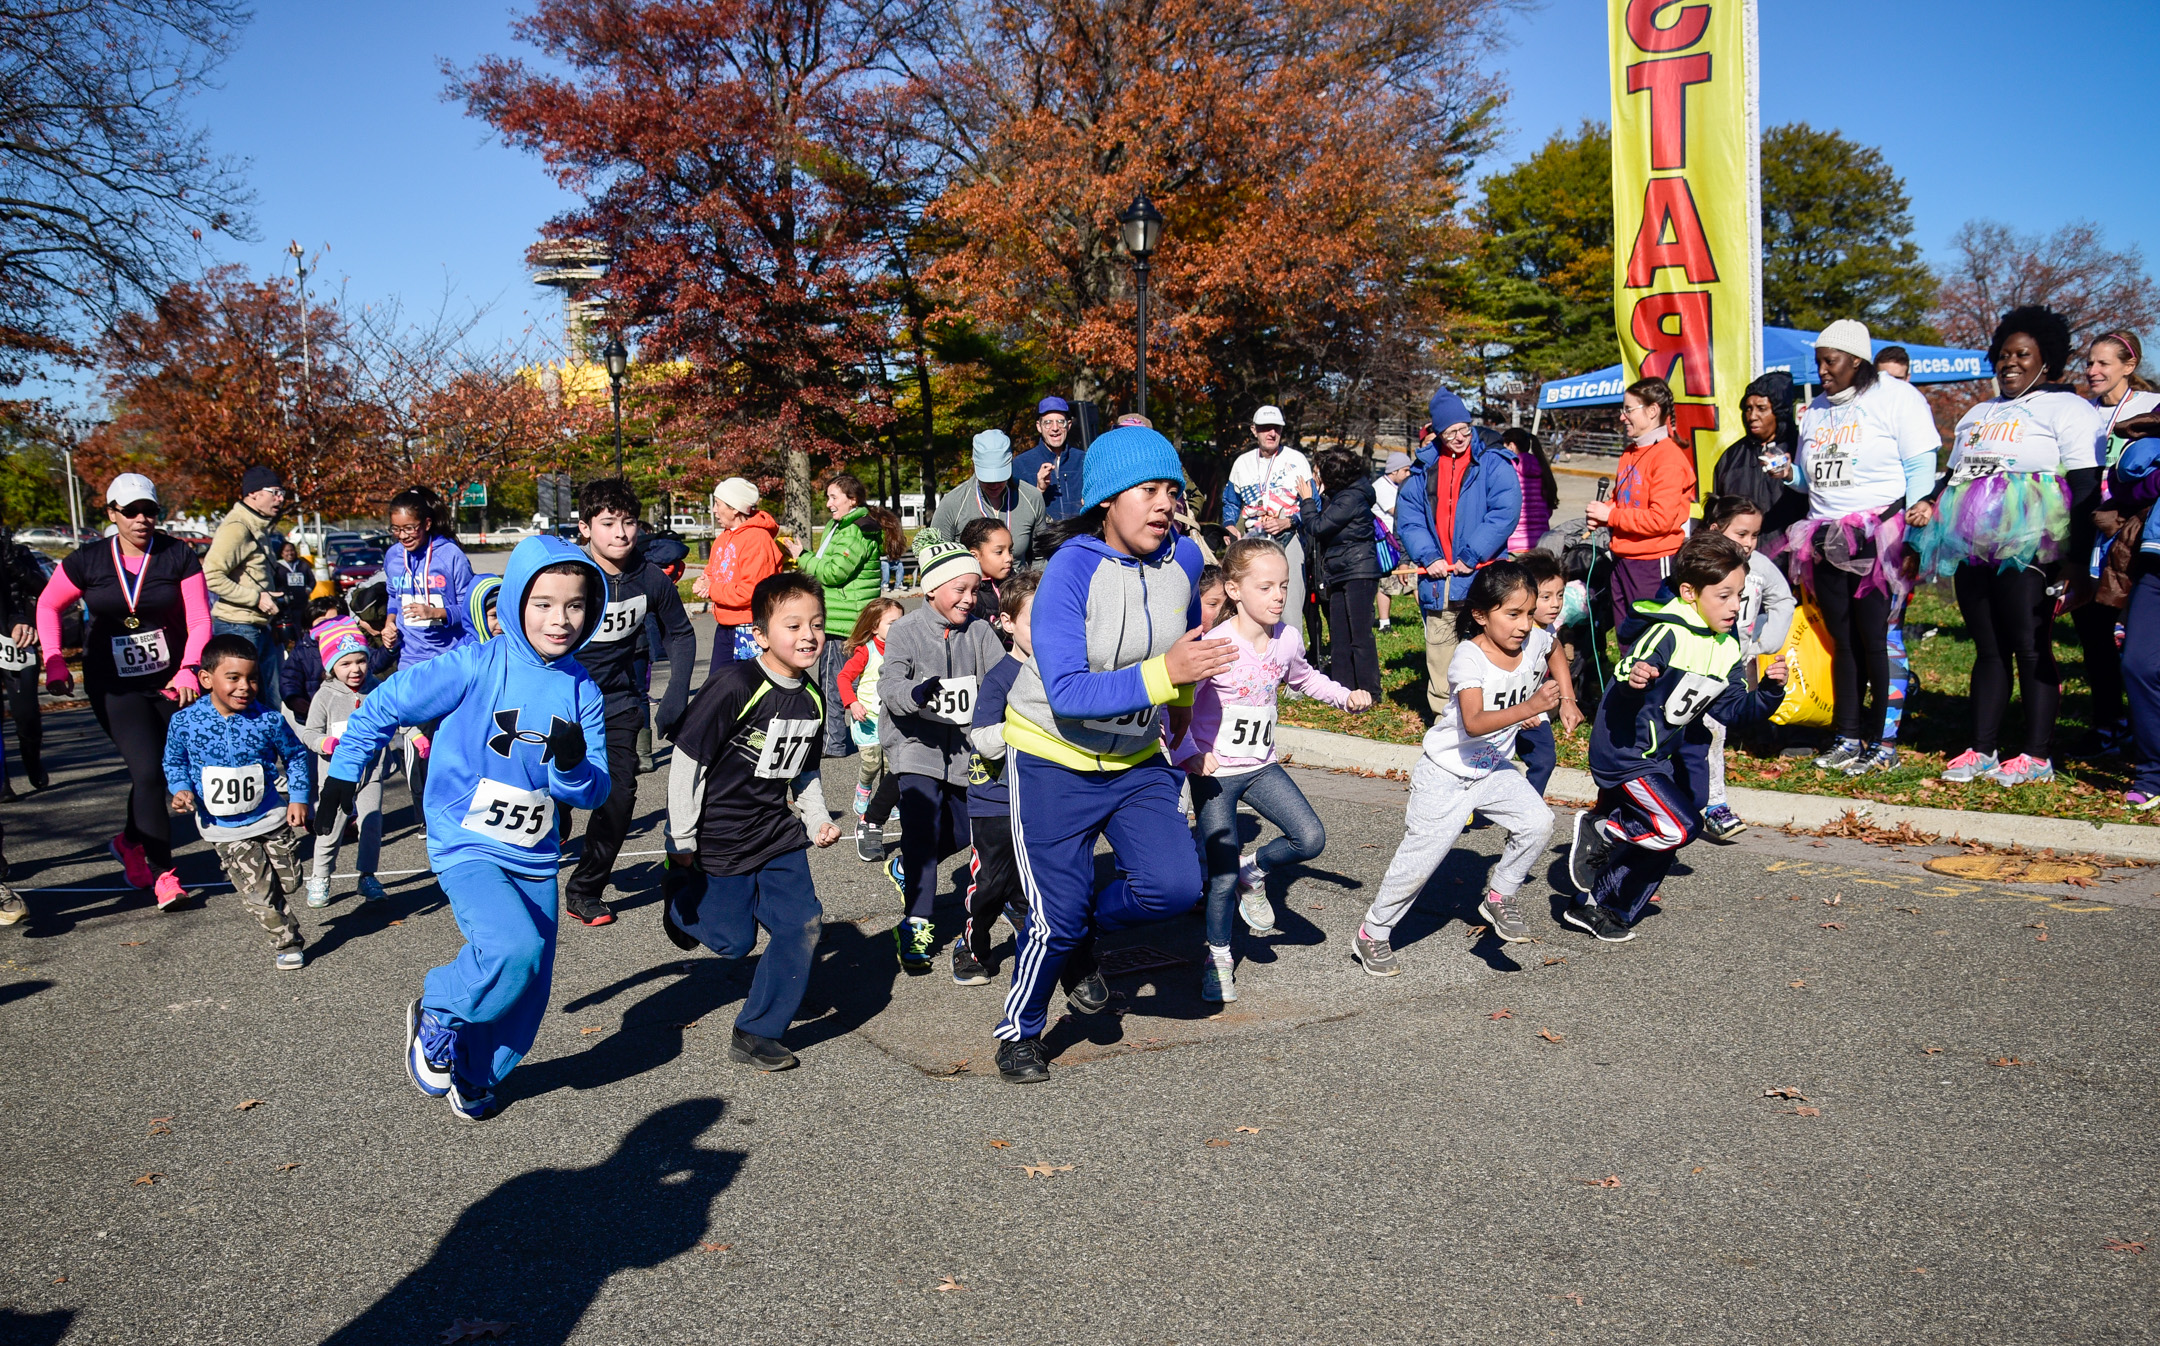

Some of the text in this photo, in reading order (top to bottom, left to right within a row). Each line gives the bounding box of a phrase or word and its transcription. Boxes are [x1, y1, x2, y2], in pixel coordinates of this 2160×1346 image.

[1815, 461, 1843, 479] 677
[603, 608, 636, 633] 551
[0, 641, 28, 664] 95
[123, 643, 160, 666] 635
[1232, 718, 1272, 746] 510
[211, 776, 255, 804] 296
[484, 799, 545, 835] 555
